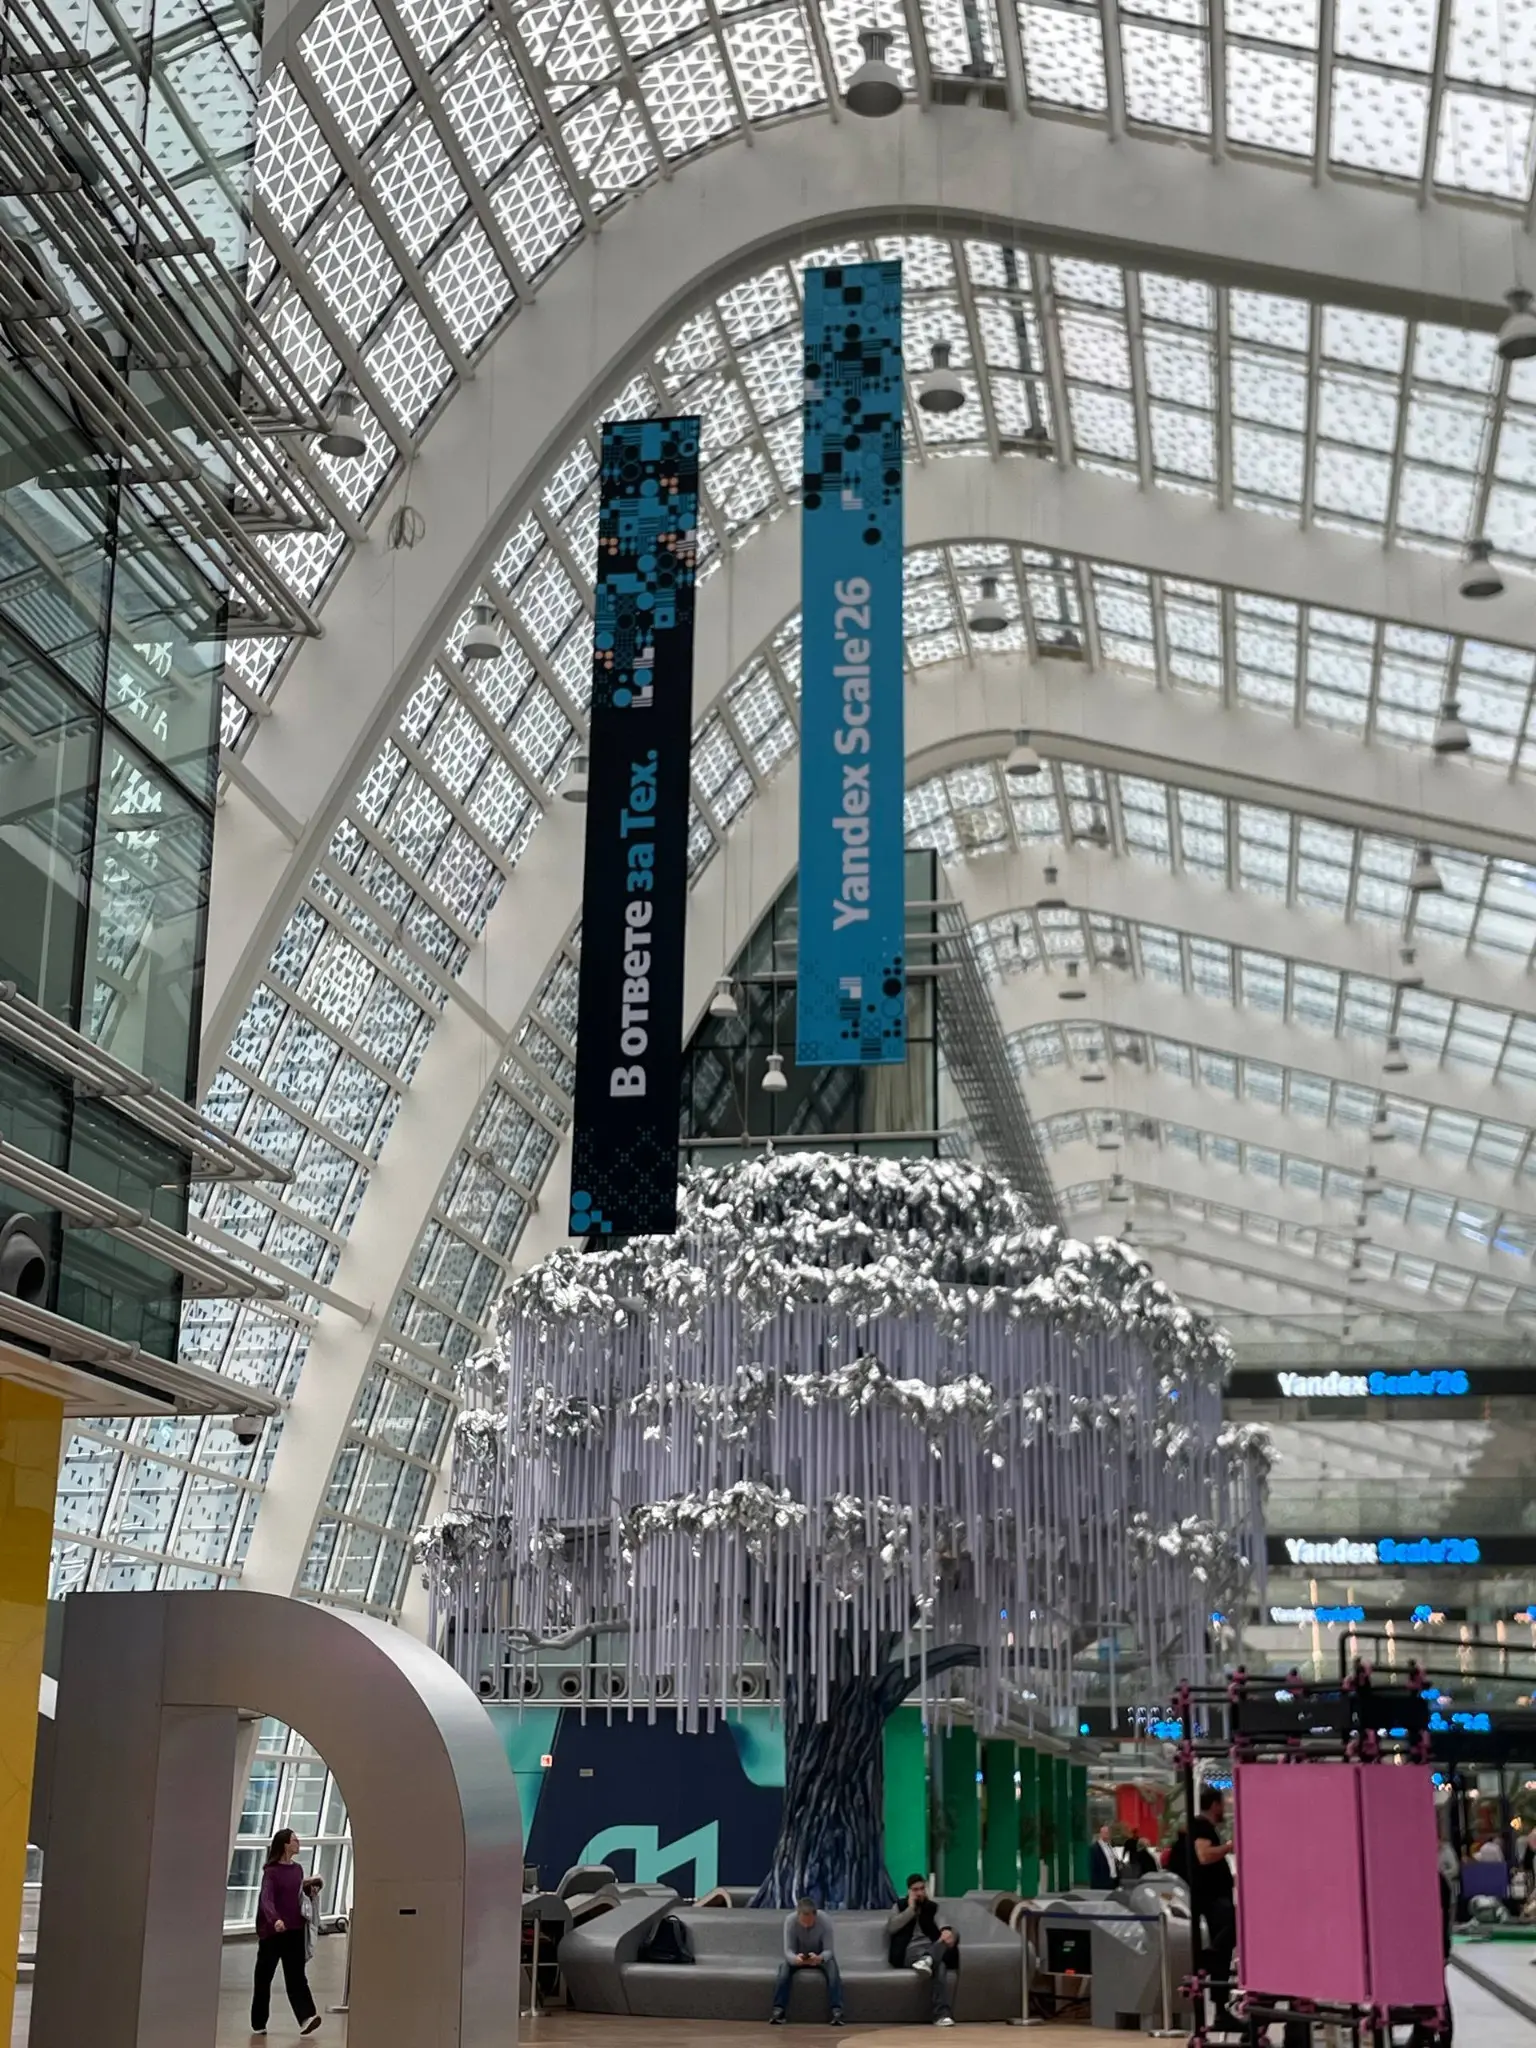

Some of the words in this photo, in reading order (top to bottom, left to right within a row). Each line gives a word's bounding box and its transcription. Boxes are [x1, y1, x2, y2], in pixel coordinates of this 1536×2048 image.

[832, 576, 871, 755] Scale'26
[620, 749, 658, 839] Тех.
[626, 843, 654, 892] за
[832, 763, 870, 931] Yandex
[620, 900, 653, 1056] ответе
[610, 1064, 646, 1097] В
[1277, 1370, 1369, 1396] Yandex
[1284, 1537, 1378, 1563] Yandex
